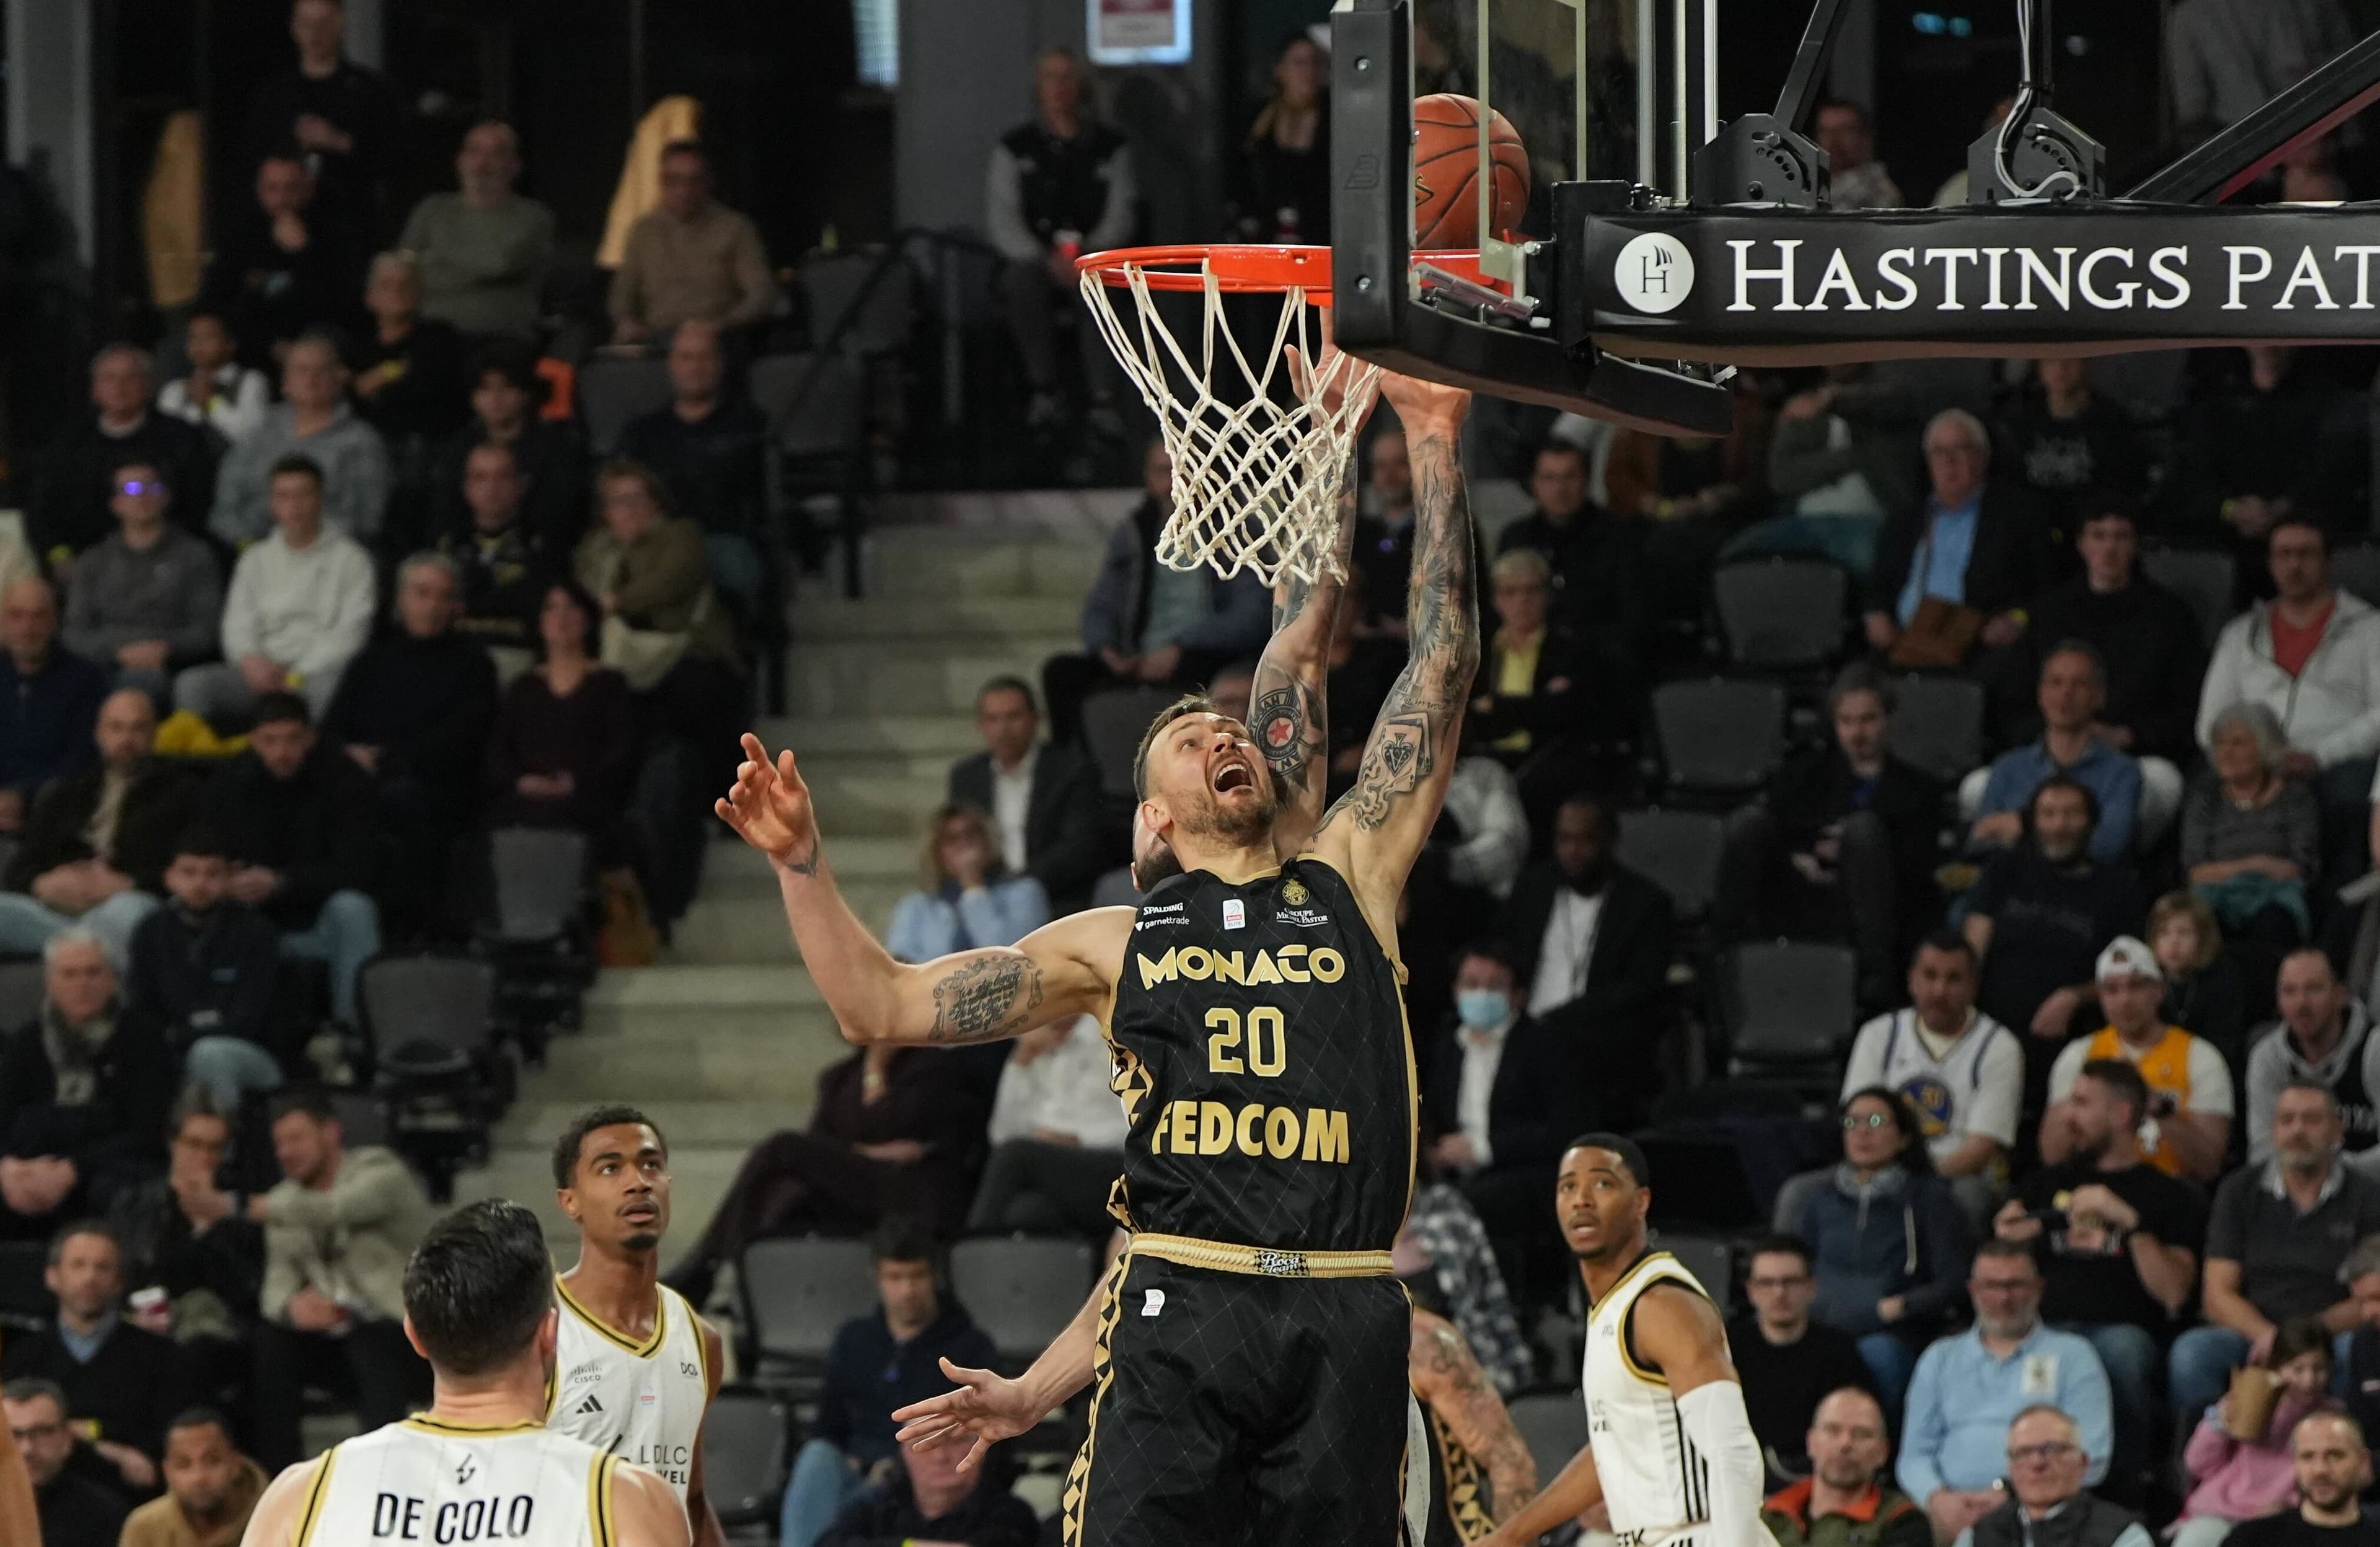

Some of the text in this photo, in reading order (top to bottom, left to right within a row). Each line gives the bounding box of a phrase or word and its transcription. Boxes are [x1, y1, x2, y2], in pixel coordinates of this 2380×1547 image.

[1726, 240, 2192, 312] HASTINGS
[1144, 902, 1183, 915] SPALDING
[1145, 916, 1190, 929] garnettrade
[1137, 944, 1346, 990] MONACO
[1204, 1006, 1286, 1077] 20
[1152, 1100, 1350, 1165] FEDCOM
[1261, 1252, 1300, 1267] Roca
[1264, 1263, 1298, 1274] Team
[640, 1444, 687, 1465] LDLC
[372, 1492, 534, 1545] DE COLO
